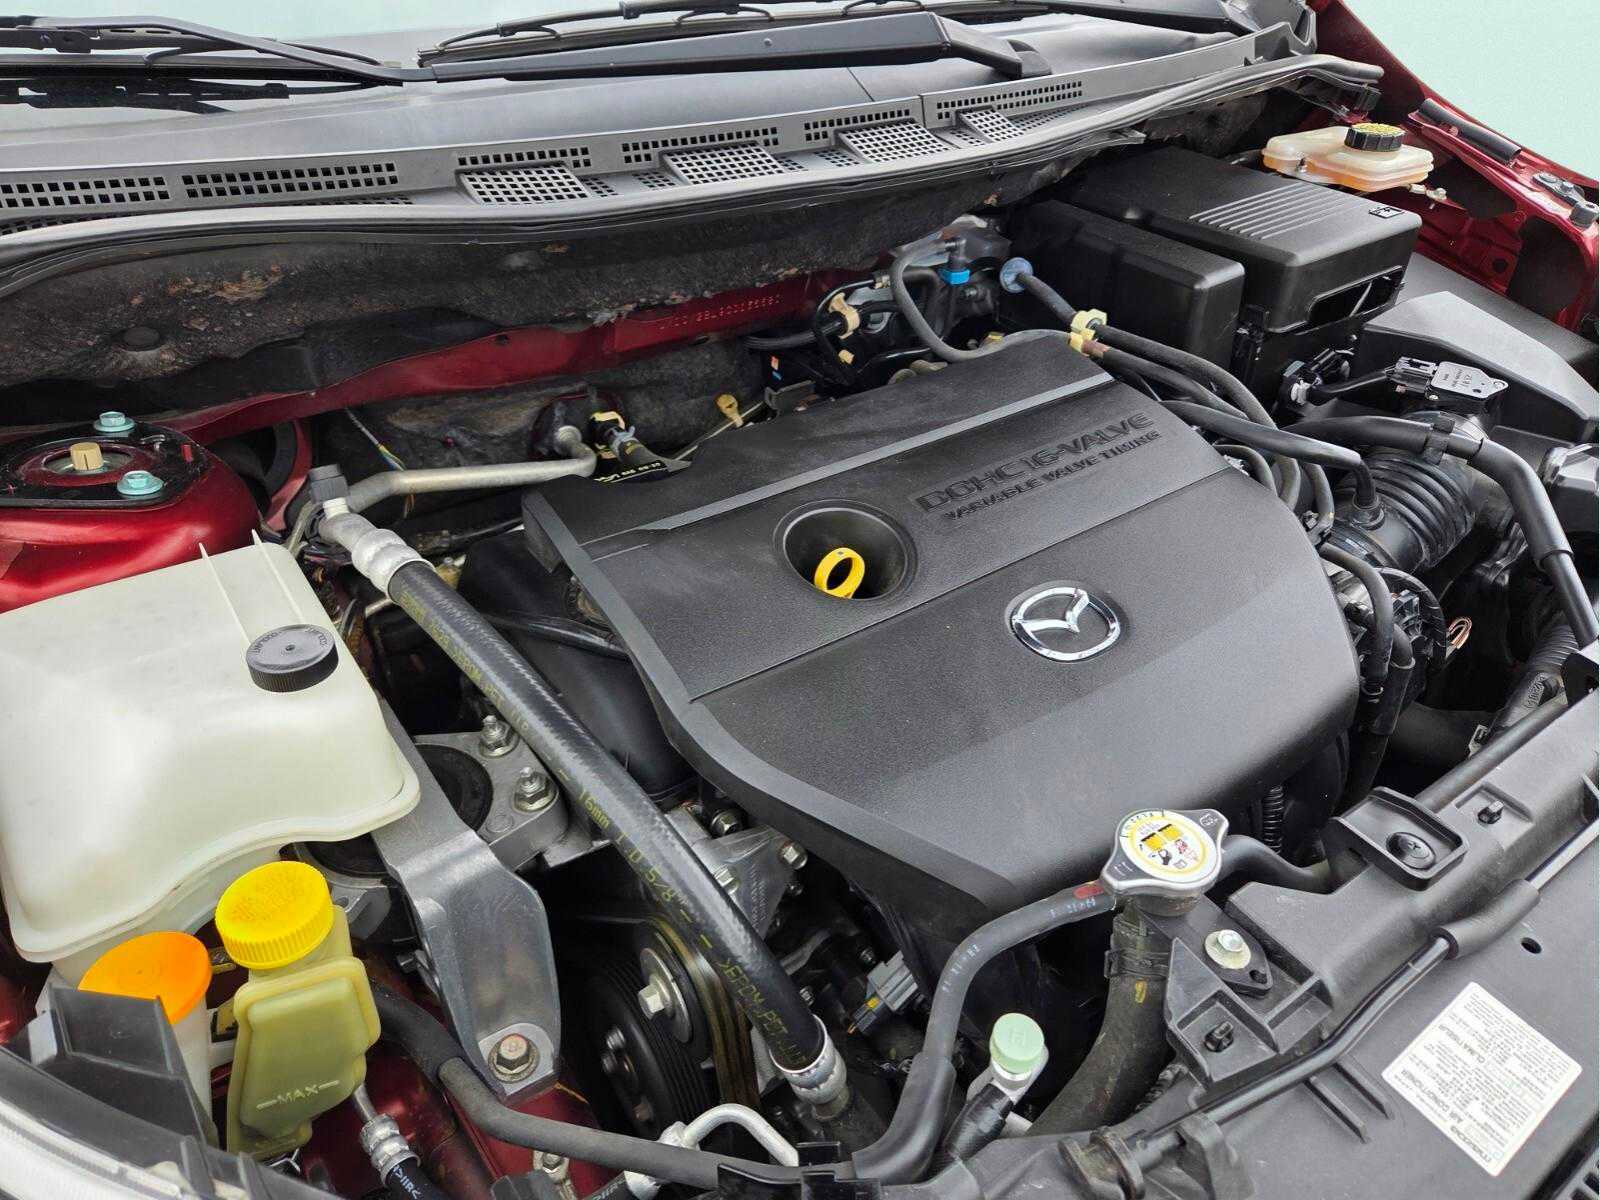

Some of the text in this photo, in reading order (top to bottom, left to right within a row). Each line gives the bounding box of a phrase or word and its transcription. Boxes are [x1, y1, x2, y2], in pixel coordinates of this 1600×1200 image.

[916, 459, 1030, 512] DOHC
[944, 432, 1161, 521] VARIABLE VALVE TIMING
[278, 1086, 318, 1102] MAX
[1401, 1069, 1449, 1112] CONDITIONER
[1450, 1124, 1492, 1163] mazda
